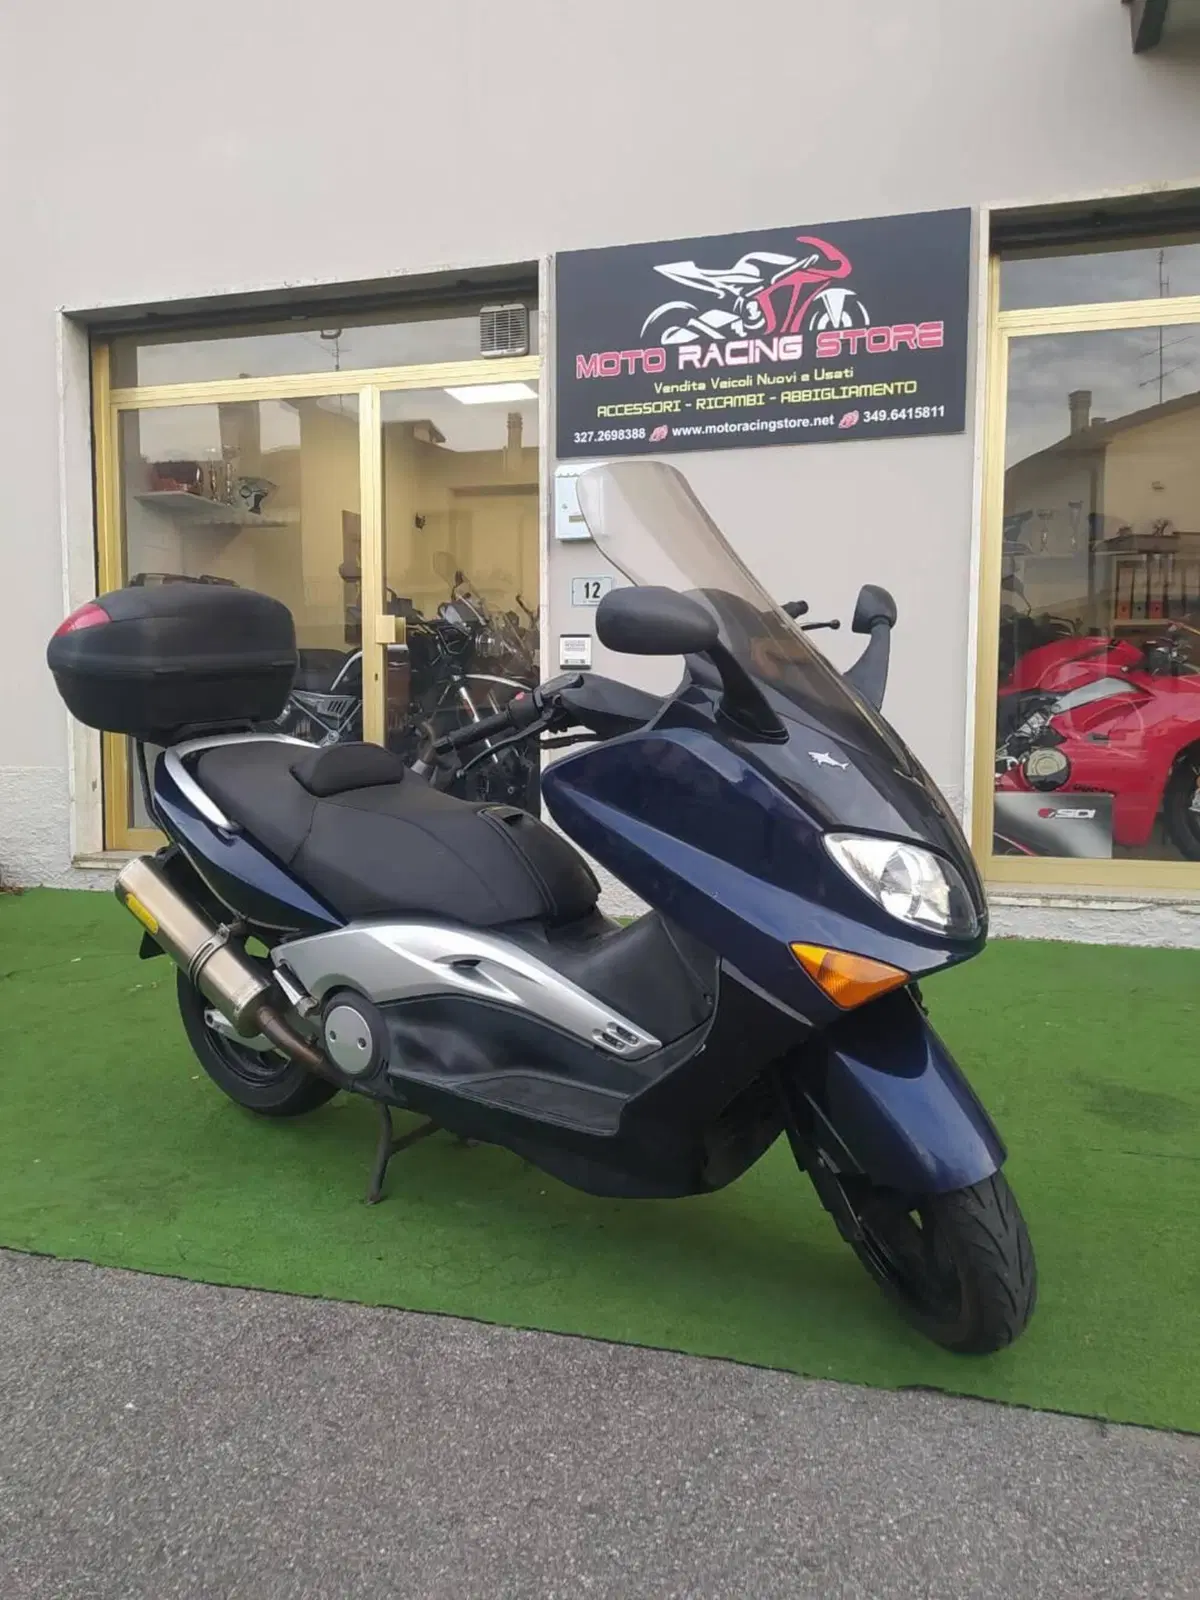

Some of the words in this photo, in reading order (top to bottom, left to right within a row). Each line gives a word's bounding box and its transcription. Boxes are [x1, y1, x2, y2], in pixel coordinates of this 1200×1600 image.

[576, 347, 667, 379] MOTO
[678, 335, 803, 370] RACING
[816, 321, 944, 359] STORE
[654, 379, 706, 394] Vendita
[711, 375, 753, 389] Veicoli
[756, 371, 797, 385] Nuovi
[800, 373, 811, 382] e
[814, 366, 854, 381] Usati
[597, 400, 682, 418] ACCESSORI
[696, 393, 766, 411] RICAMBI
[780, 380, 917, 404] ABBIGLIAMENTO
[671, 414, 834, 437] www.motoracingstore.net
[863, 405, 945, 423] 349.6415811
[573, 427, 647, 444] 327.2698388
[584, 581, 601, 599] 12
